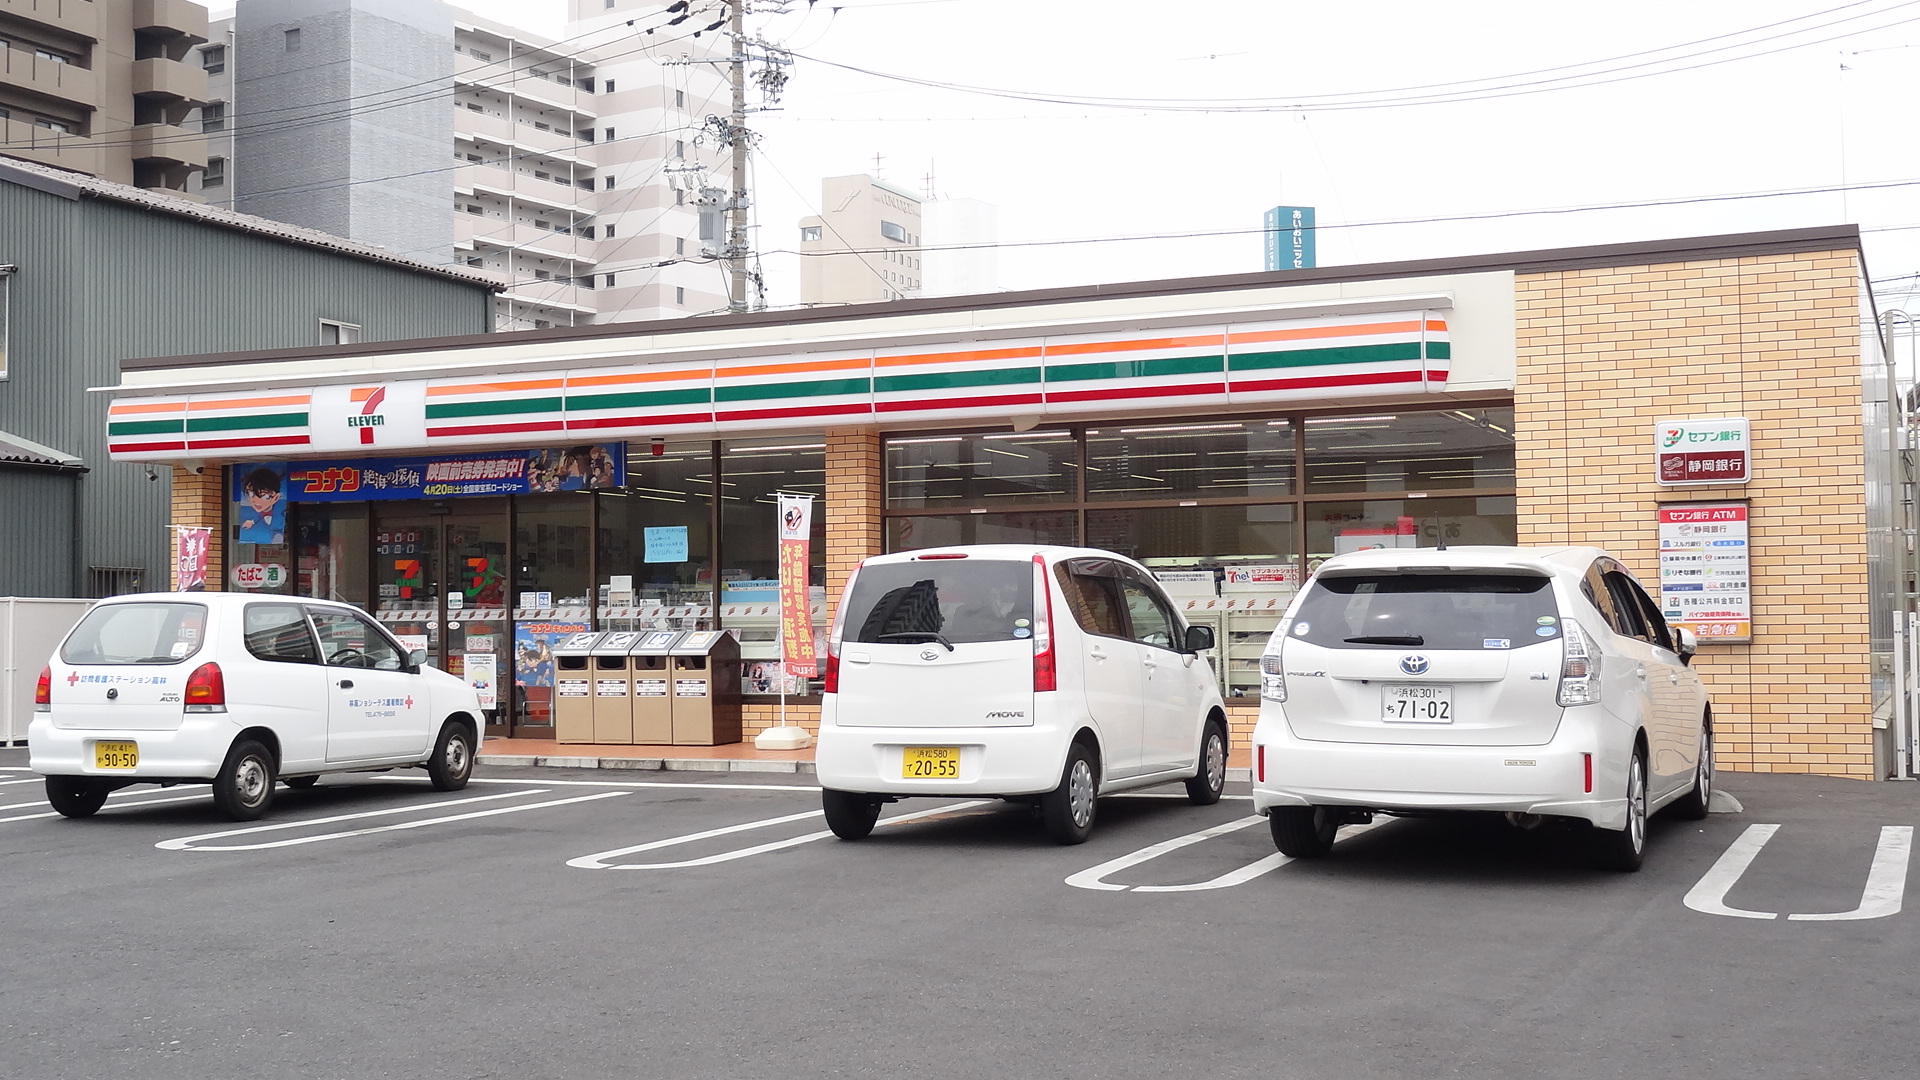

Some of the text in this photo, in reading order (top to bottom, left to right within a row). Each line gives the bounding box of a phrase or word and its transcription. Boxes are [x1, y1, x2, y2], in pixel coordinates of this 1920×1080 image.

[347, 415, 385, 427] ELEVEN
[1688, 430, 1741, 442] セブン銀行
[1688, 459, 1742, 472] 静岡銀行
[304, 467, 360, 493] コナン
[1669, 511, 1736, 520] セブン銀行 ATM
[1694, 525, 1727, 534] 静岡銀行
[237, 567, 279, 581] たばこ 酒
[1684, 597, 1742, 605] 各種公共料金窓口
[530, 624, 552, 633] コナン
[1397, 700, 1449, 719] 71-02
[104, 754, 136, 767] 90-50
[914, 760, 957, 775] 20-55
